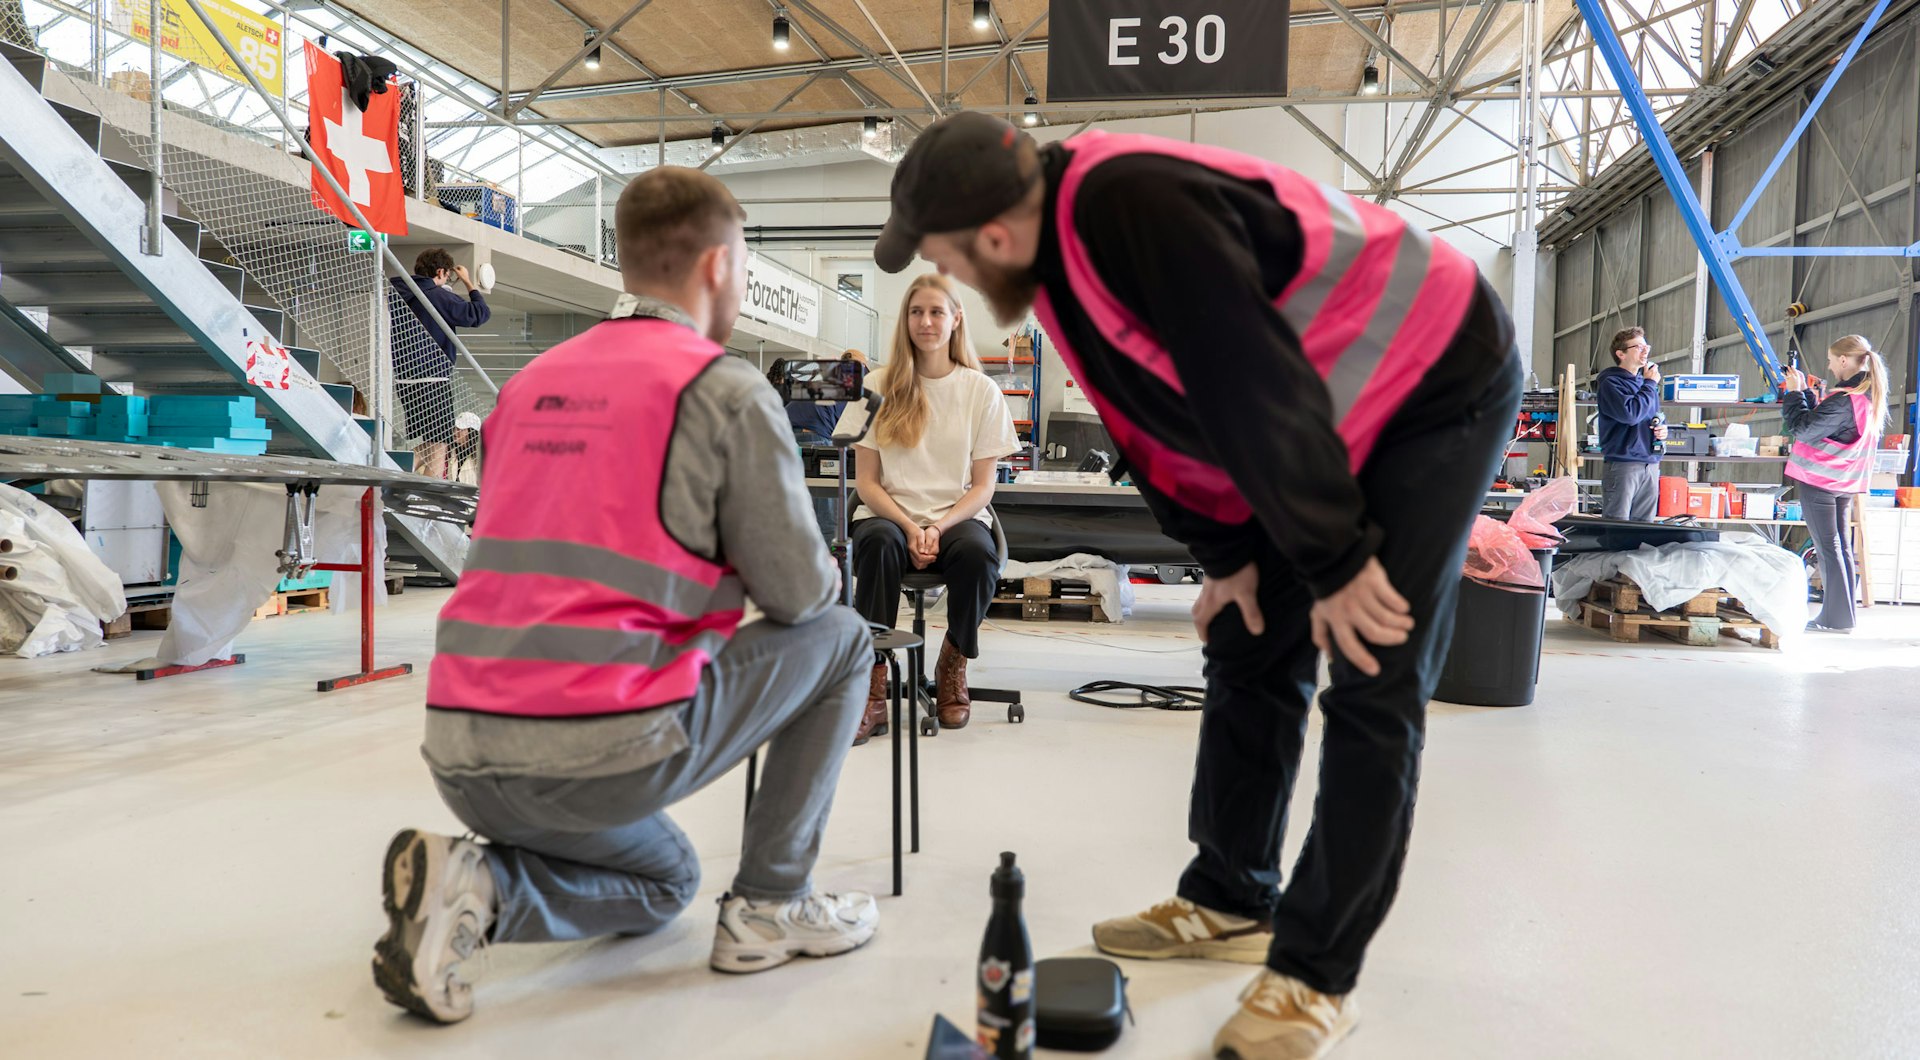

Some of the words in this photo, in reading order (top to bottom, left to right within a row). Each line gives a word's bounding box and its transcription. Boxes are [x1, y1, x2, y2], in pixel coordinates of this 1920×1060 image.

[236, 21, 264, 40] ALETSCH
[1108, 17, 1141, 66] E
[1157, 14, 1226, 65] 30
[239, 35, 278, 80] 85
[745, 270, 799, 321] ForzaETH
